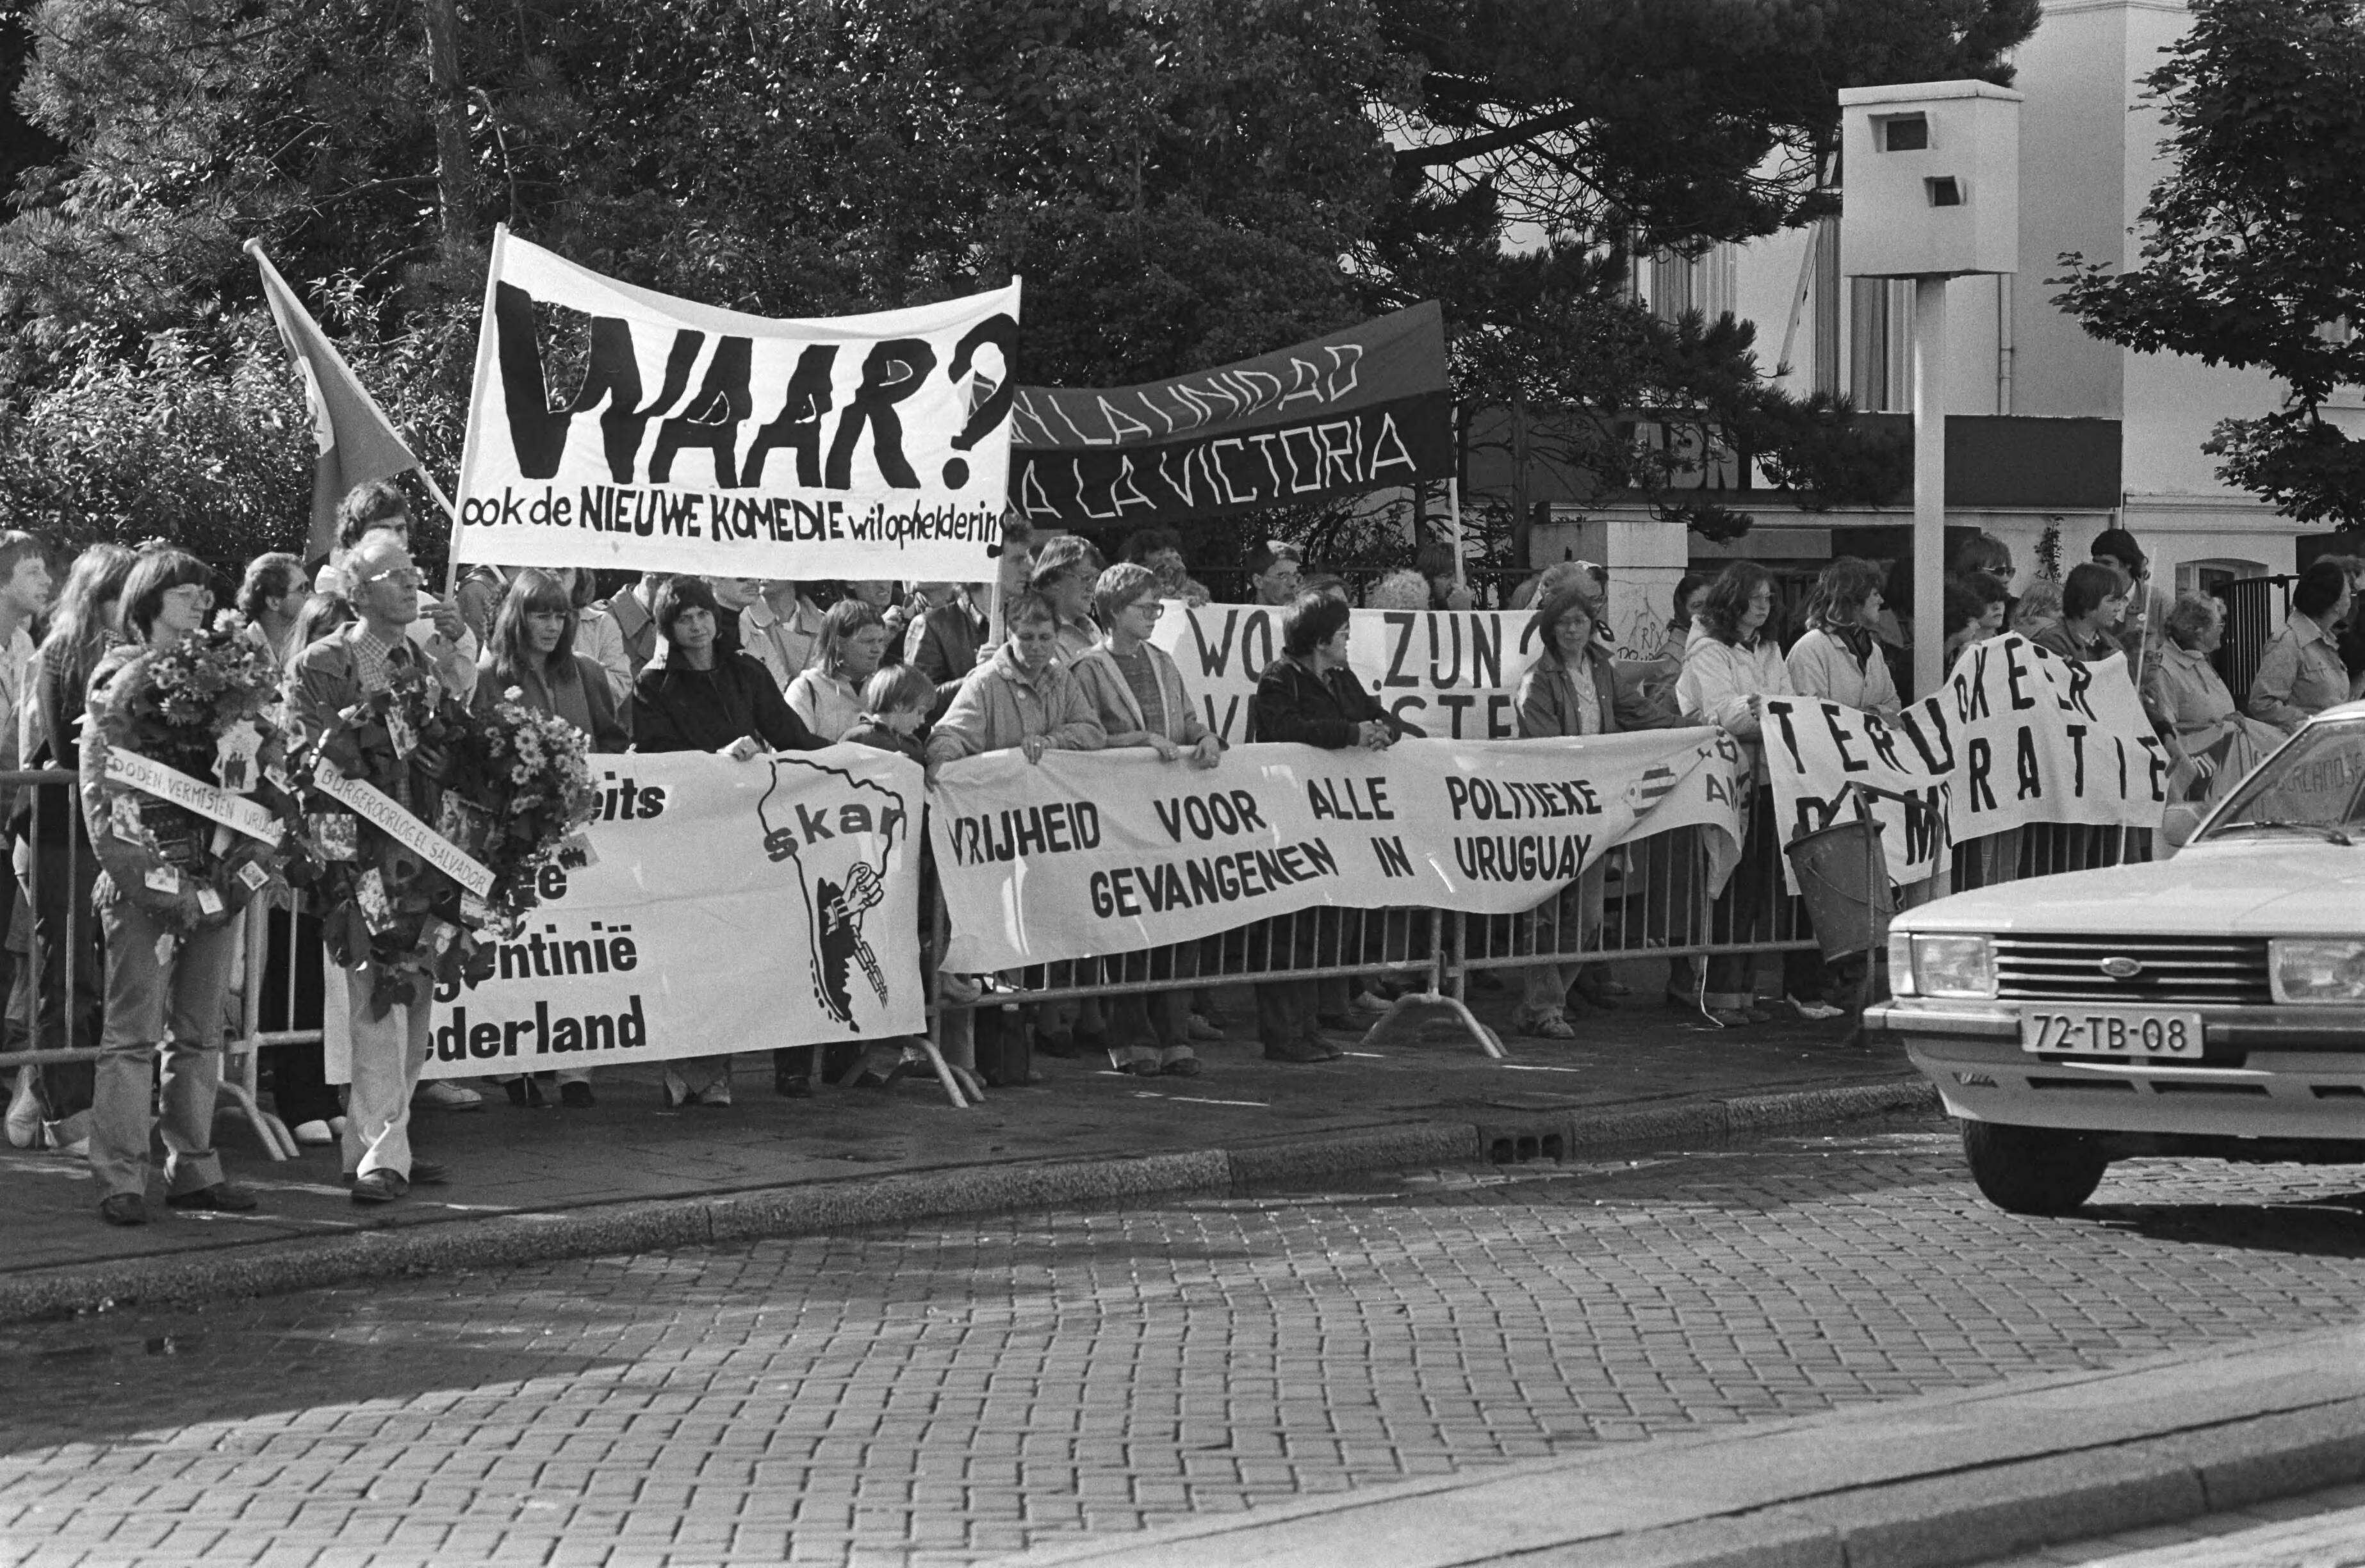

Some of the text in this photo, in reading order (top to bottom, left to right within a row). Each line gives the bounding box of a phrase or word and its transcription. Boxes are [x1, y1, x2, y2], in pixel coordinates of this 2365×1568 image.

[496, 281, 1019, 491] WAAR?
[1074, 454, 1158, 519] LA
[1159, 412, 1416, 507] VICTORIA
[462, 487, 526, 527] ook
[530, 486, 571, 527] de
[580, 485, 704, 537] NIEUWE
[710, 494, 844, 542] KOMEDIE
[849, 503, 885, 541] wil
[764, 803, 907, 863] skan
[945, 801, 1101, 867] VRIJHEID
[1153, 789, 1267, 843] VOOR
[1307, 777, 1395, 821] ALLE
[429, 842, 487, 894] SALVADOR
[1090, 834, 1592, 919] GEVANGENEN IN URUGUAY
[2033, 1015, 2186, 1052] 72-TB-08
